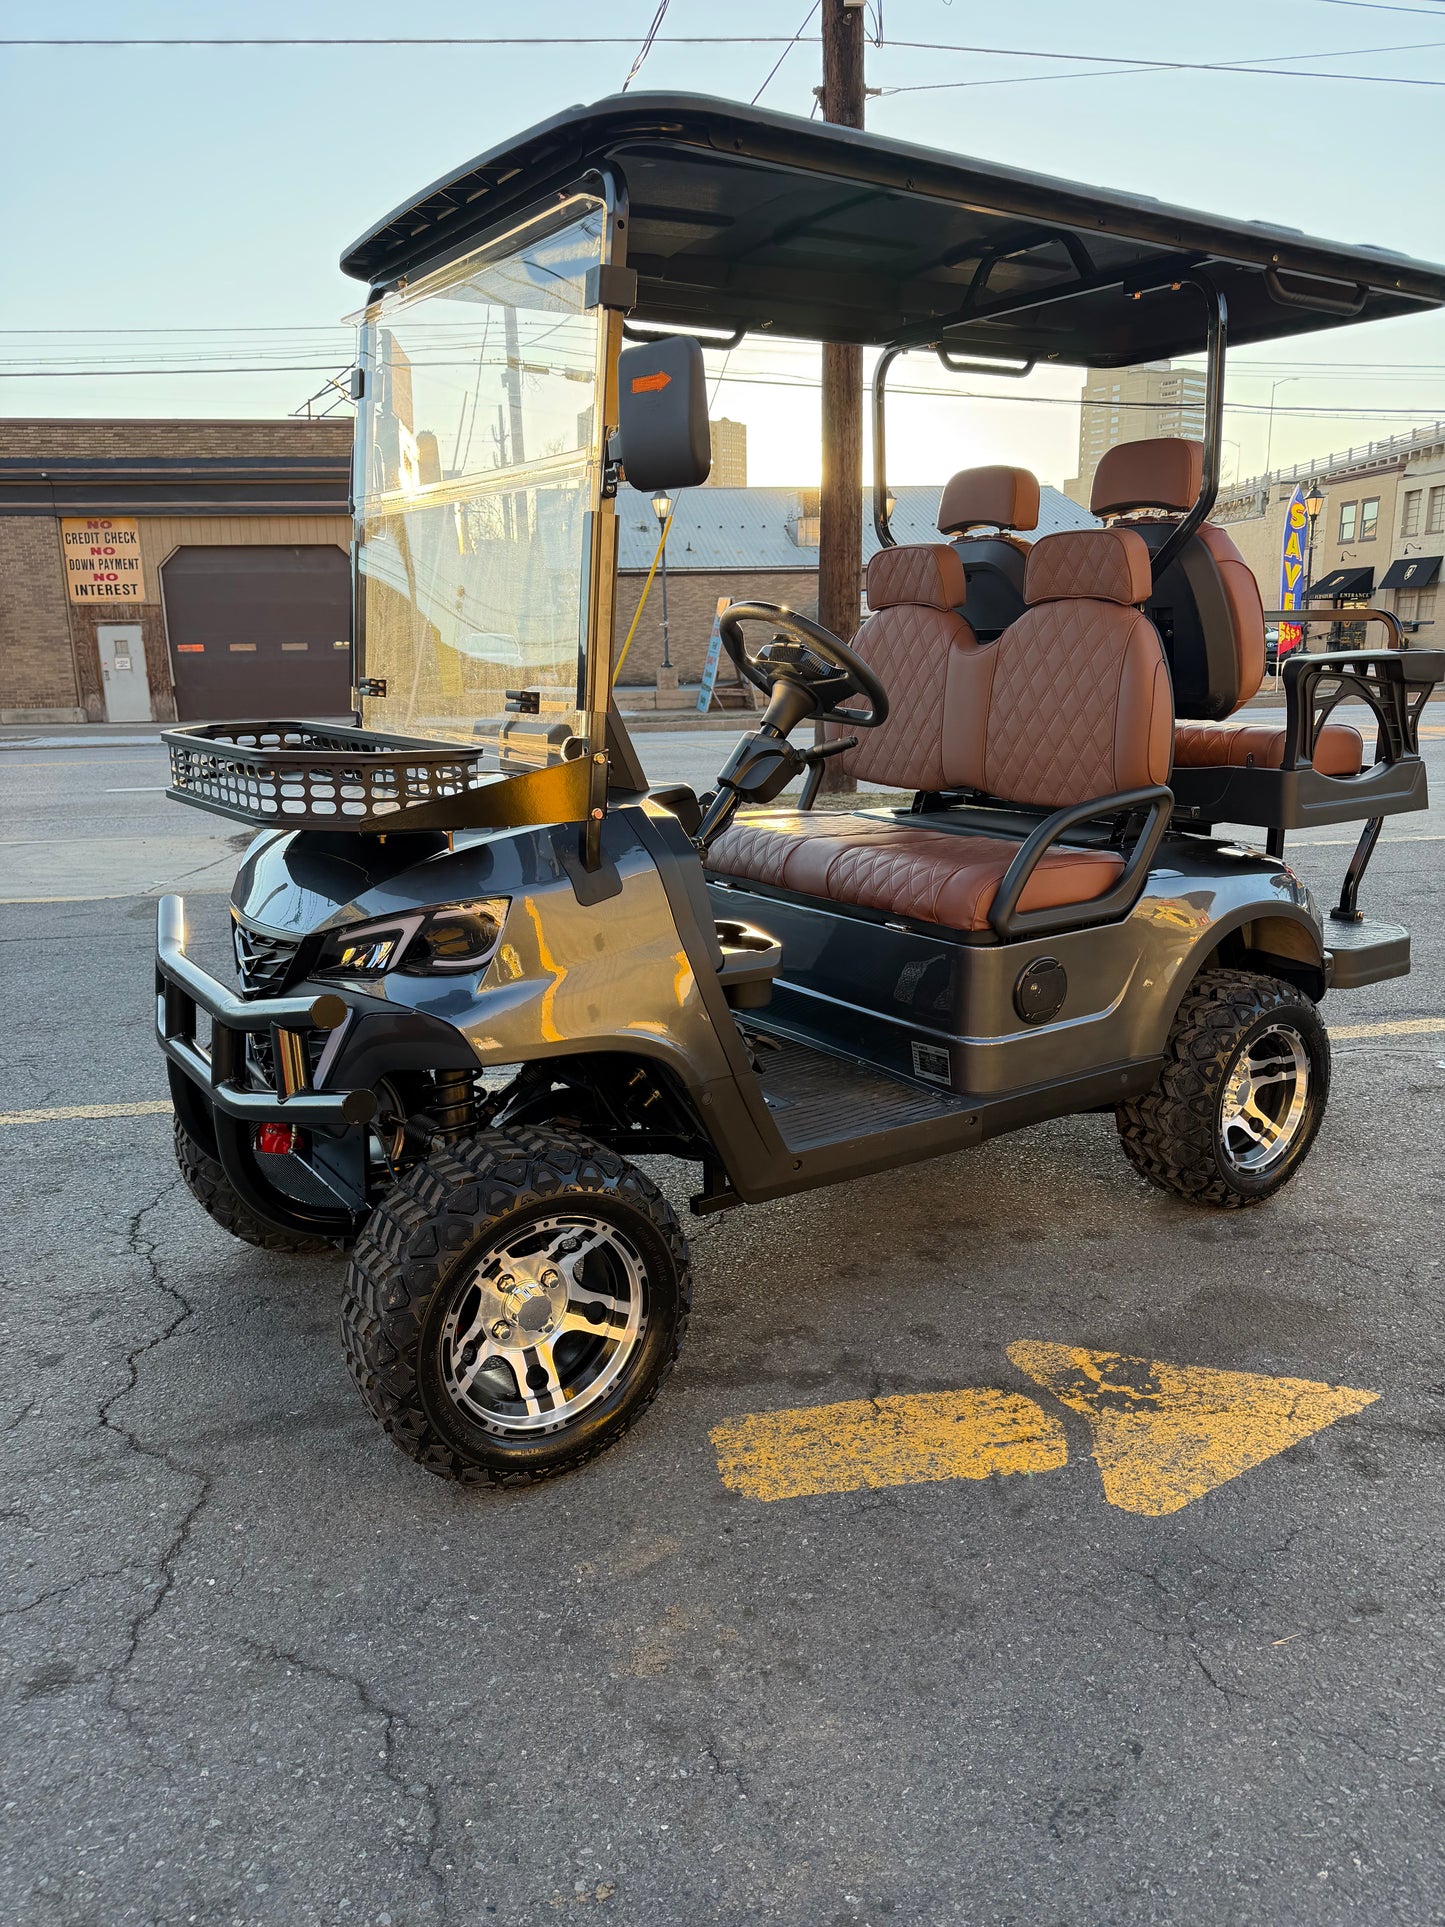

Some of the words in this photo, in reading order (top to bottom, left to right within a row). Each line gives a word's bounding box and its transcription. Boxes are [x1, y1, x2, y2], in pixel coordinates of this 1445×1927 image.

[86, 520, 112, 529] NO
[65, 532, 100, 544] CREDIT
[104, 532, 136, 544] CHECK
[90, 547, 116, 555] NO
[1284, 502, 1306, 611] SAVE
[69, 559, 95, 571] DOWN
[98, 558, 139, 570] PAYMENT
[93, 573, 118, 581] NO
[75, 584, 138, 596] INTEREST
